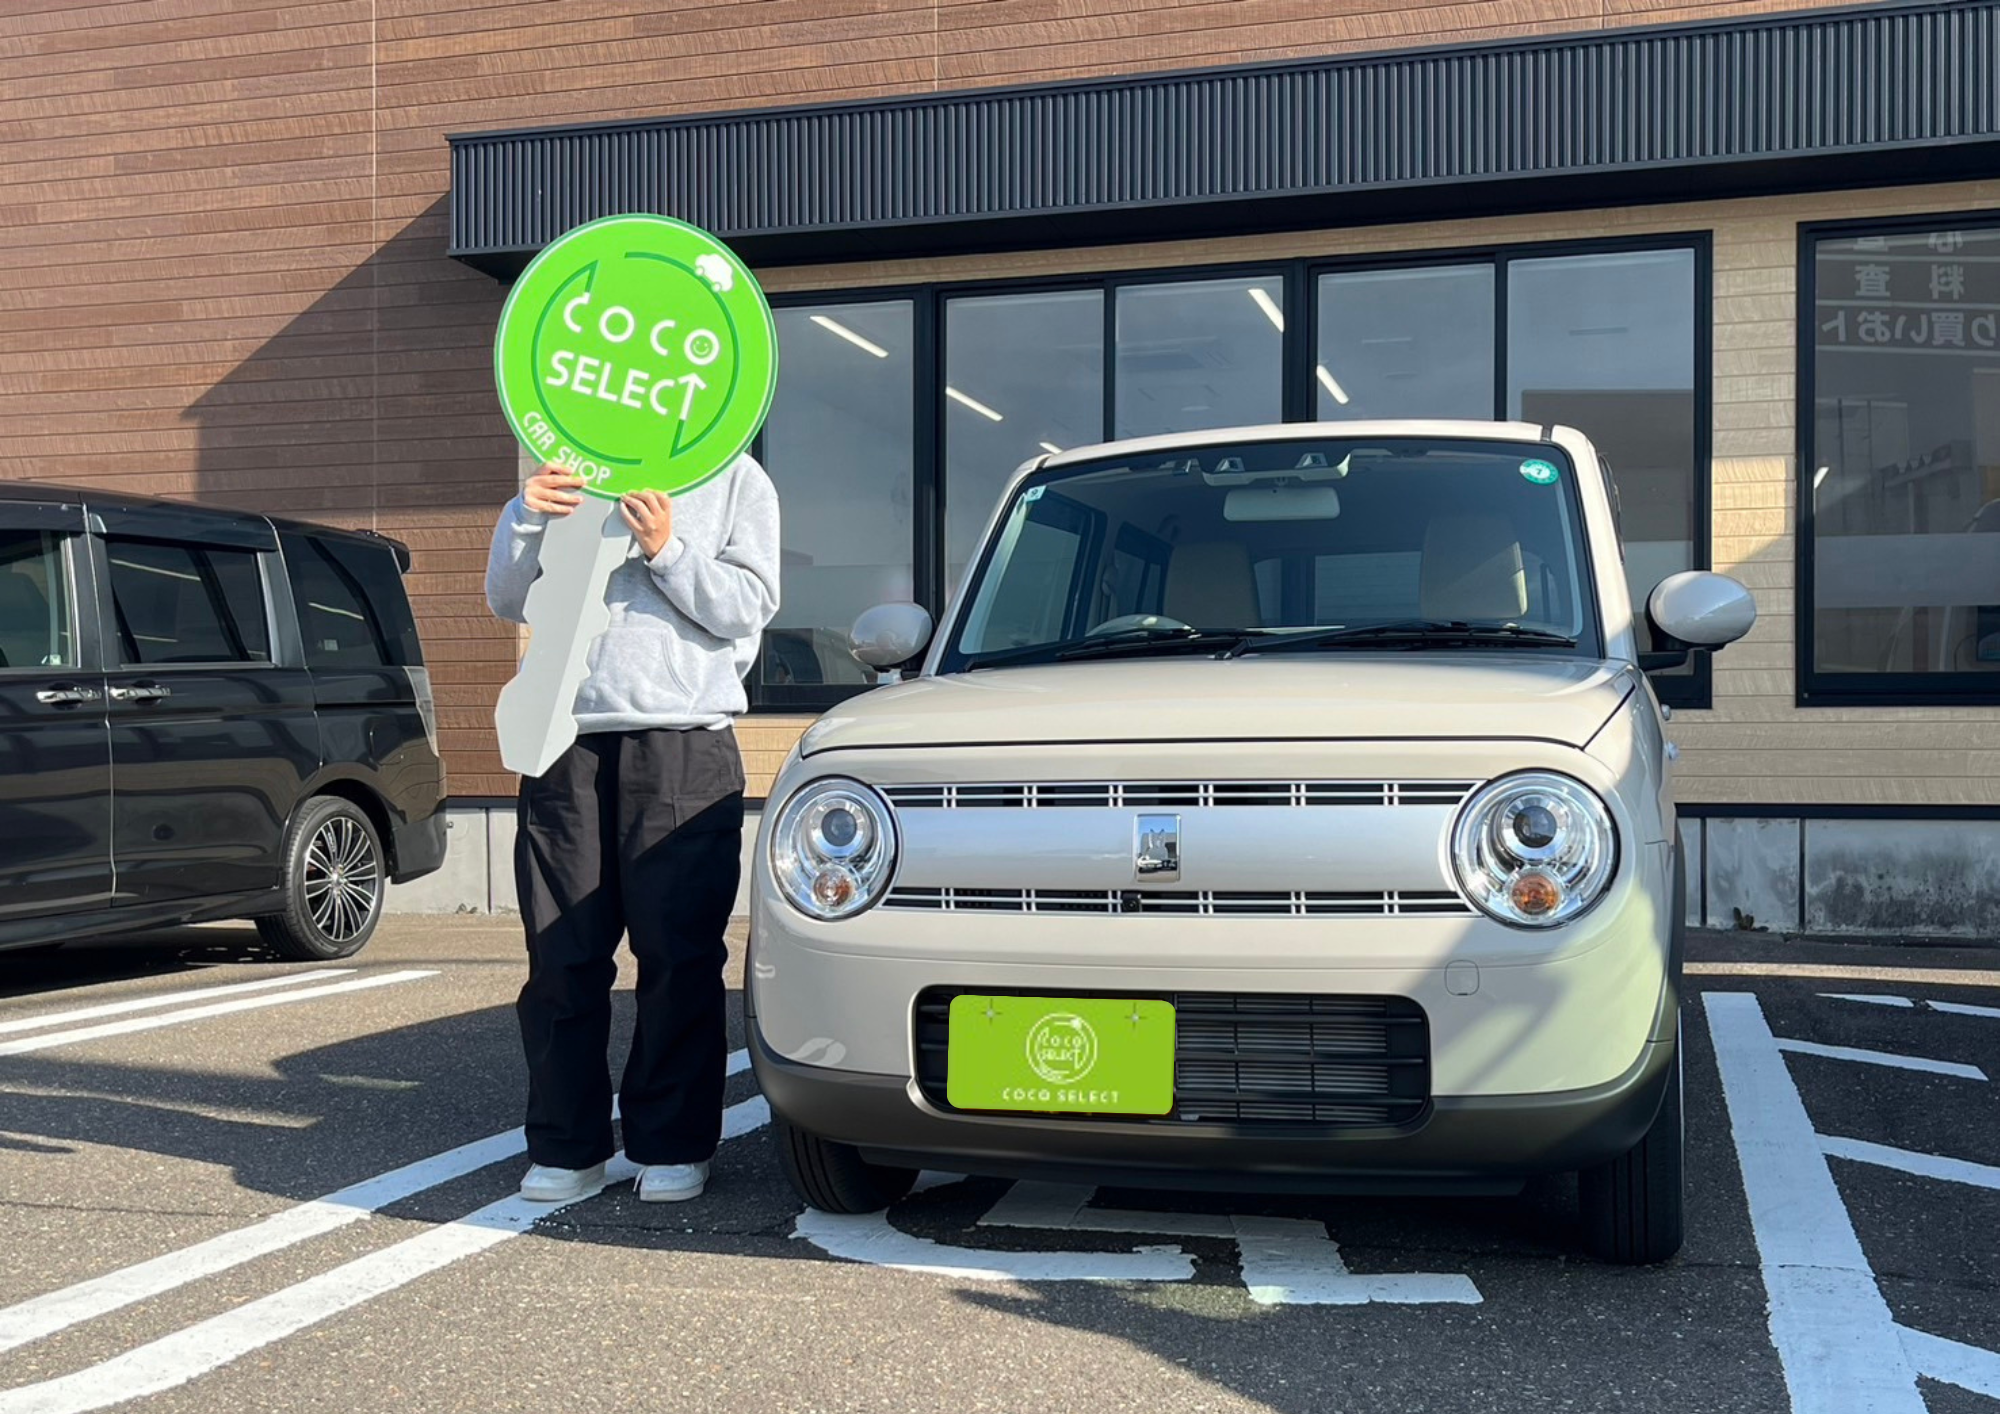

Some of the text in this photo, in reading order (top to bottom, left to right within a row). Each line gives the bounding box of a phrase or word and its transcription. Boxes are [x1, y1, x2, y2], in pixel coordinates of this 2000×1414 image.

[562, 291, 721, 366] COCO
[545, 349, 708, 421] SELECT
[522, 410, 612, 485] CAR SHOP
[1002, 1087, 1120, 1104] COCO SELECT
